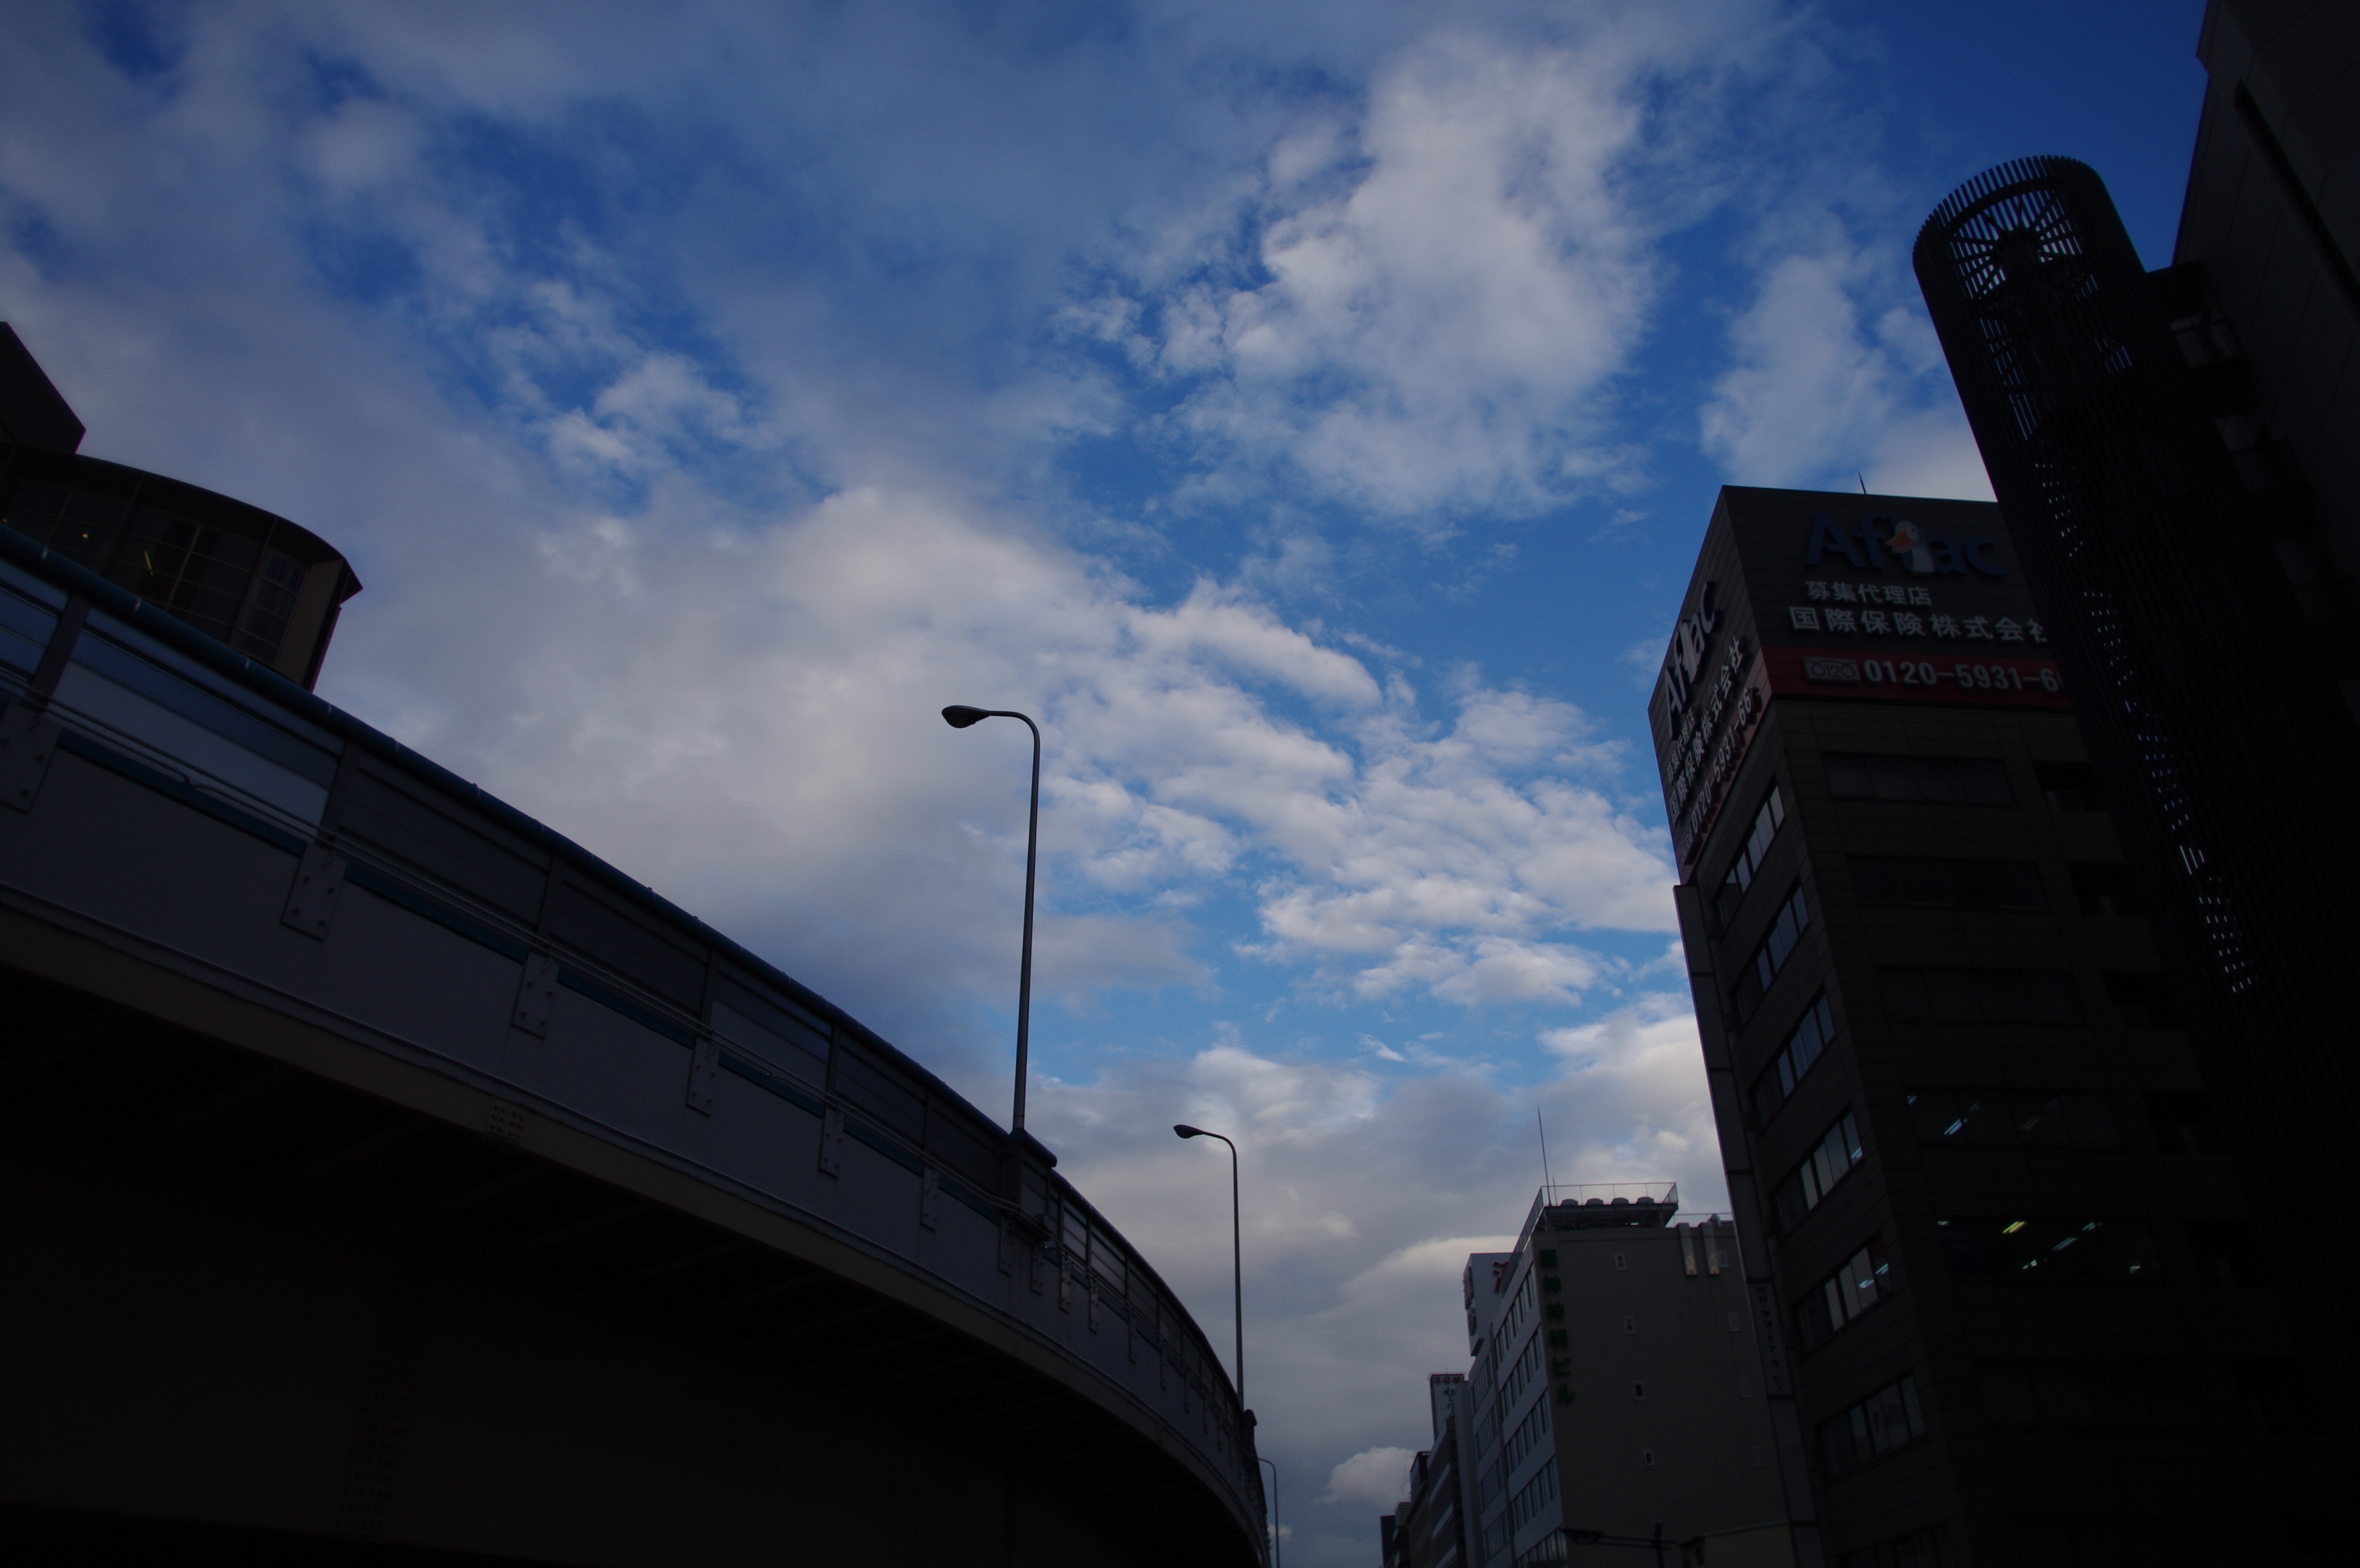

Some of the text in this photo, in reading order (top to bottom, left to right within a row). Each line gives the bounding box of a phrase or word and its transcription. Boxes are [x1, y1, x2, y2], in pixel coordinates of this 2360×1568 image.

[1804, 511, 2008, 579] Aflac
[1805, 580, 1933, 607] 募集代理店
[1863, 659, 2064, 692] 0120-5931-6
[1668, 635, 1745, 826] 国際保険株式会社
[1691, 688, 1752, 834] 0120-5931-66
